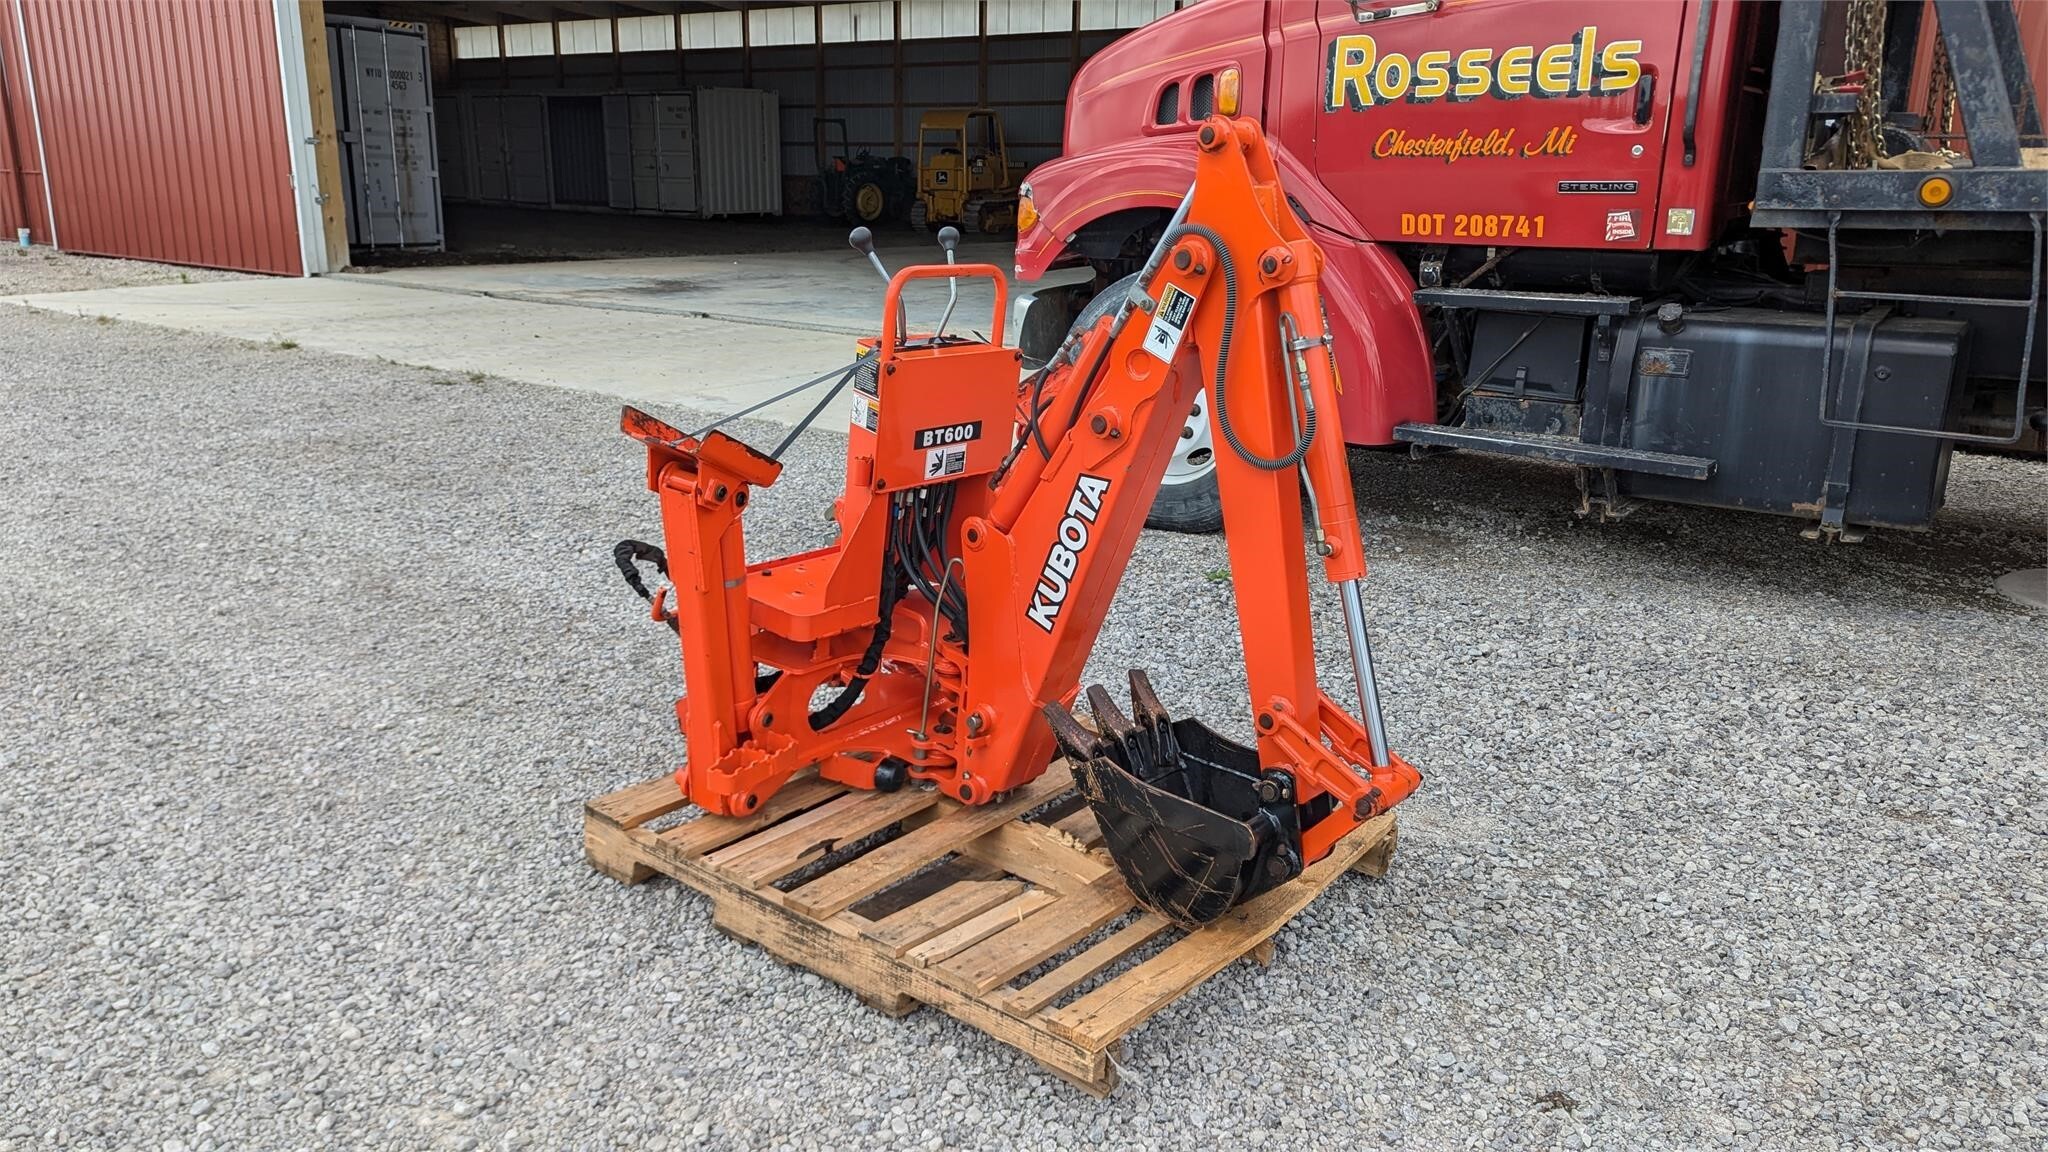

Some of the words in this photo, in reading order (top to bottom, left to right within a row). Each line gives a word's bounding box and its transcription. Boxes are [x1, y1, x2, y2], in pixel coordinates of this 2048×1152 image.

[1328, 26, 1642, 110] Rosseels
[1374, 128, 1516, 162] Chesterfield,
[1523, 126, 1578, 157] Mi
[1560, 182, 1636, 191] STERLING
[1402, 213, 1446, 235] DOT
[1454, 215, 1545, 238] 208741
[922, 424, 974, 447] BT600
[1026, 474, 1110, 633] KUBOTA
